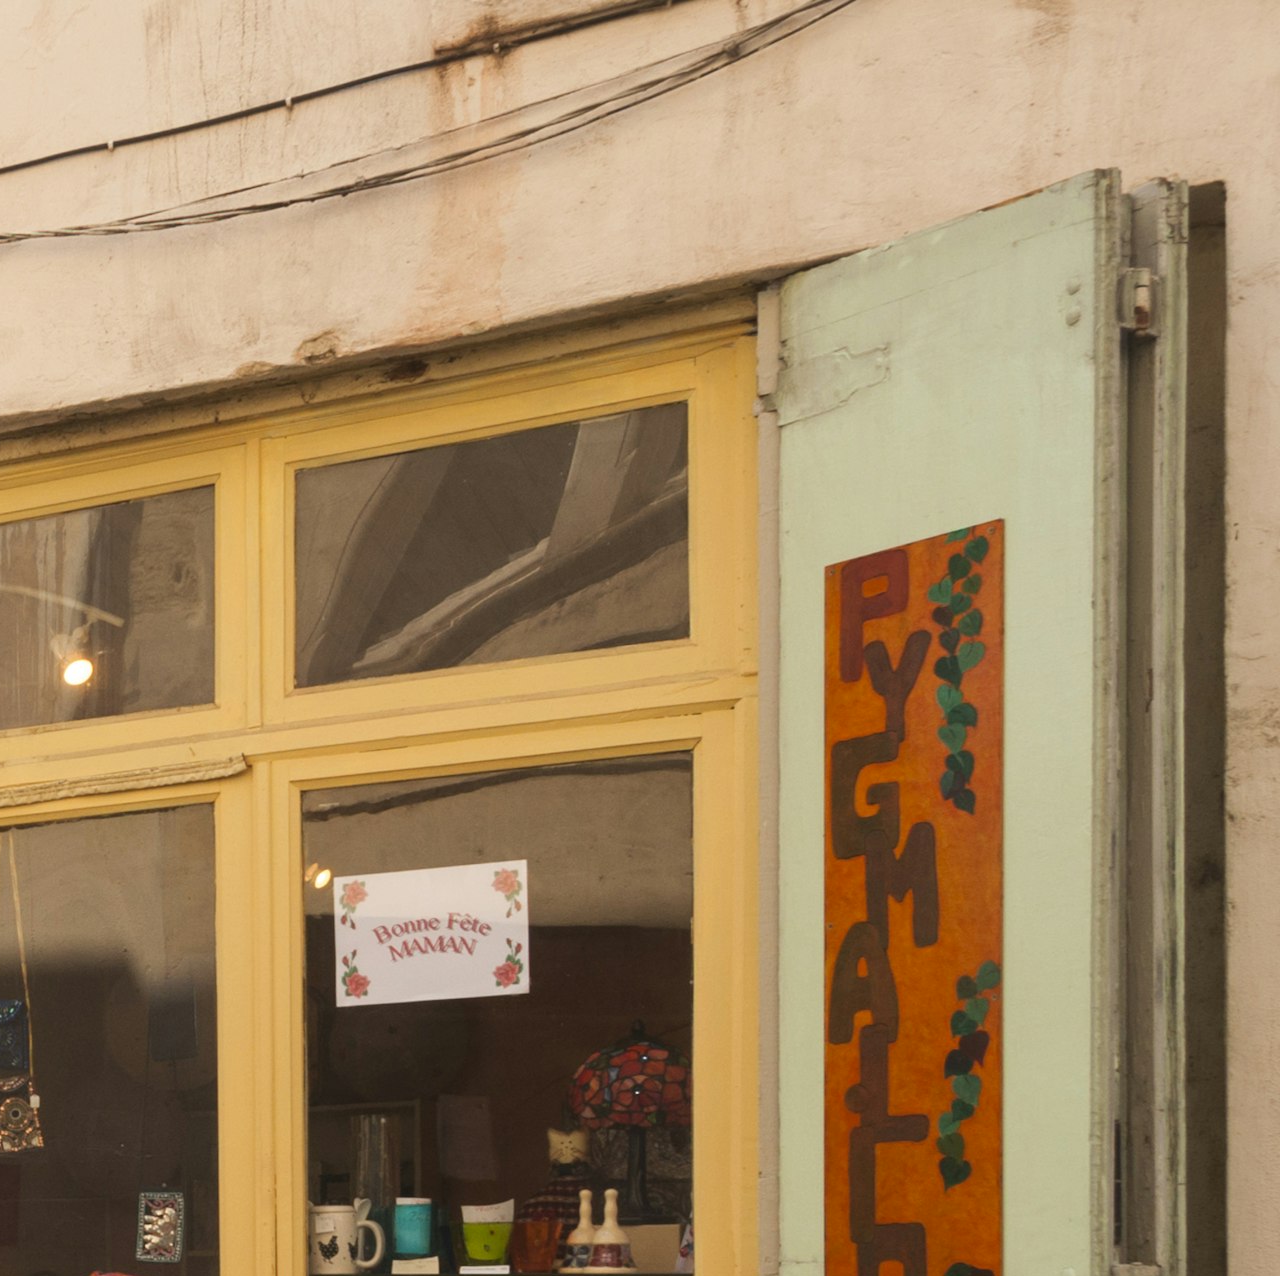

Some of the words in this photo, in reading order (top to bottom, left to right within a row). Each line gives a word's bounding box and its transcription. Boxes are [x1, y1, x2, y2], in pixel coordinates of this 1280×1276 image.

[372, 915, 441, 944] Bonne
[447, 911, 493, 937] Fête
[388, 935, 478, 962] MAMAN
